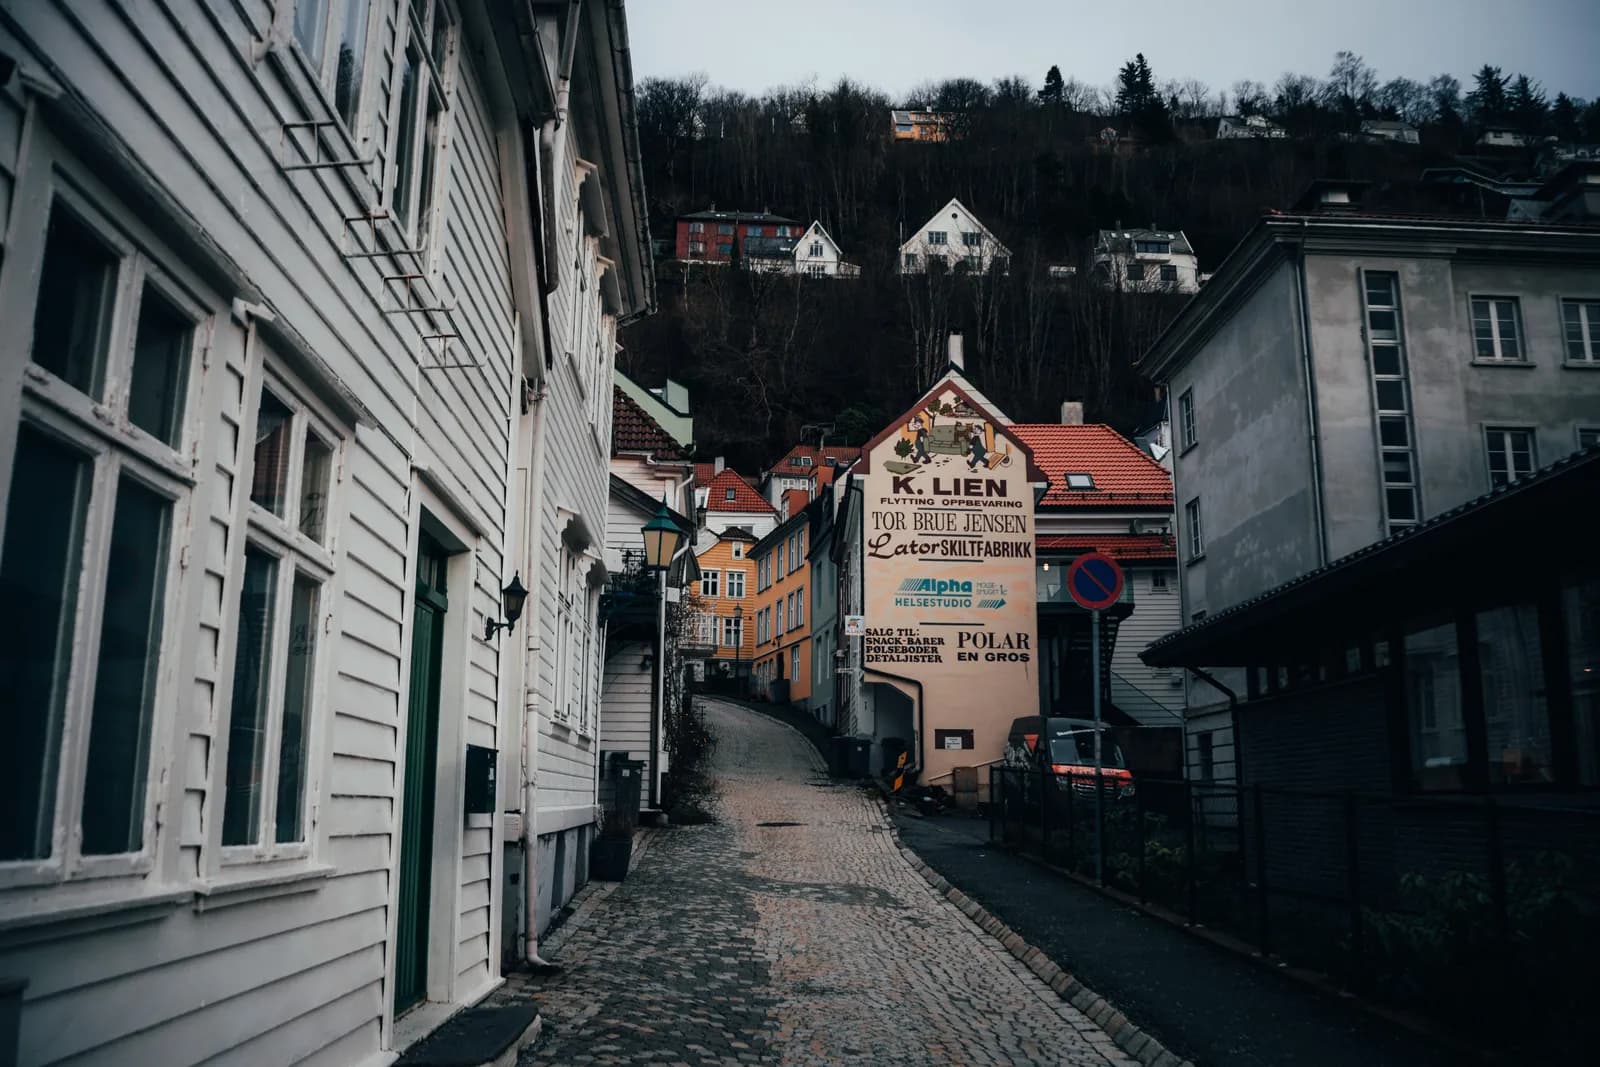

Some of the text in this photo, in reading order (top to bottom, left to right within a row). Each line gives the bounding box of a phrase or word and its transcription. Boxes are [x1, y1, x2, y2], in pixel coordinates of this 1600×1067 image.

[893, 476, 1007, 497] K. LIEN
[880, 497, 1023, 508] FLYTTING OPPBEVARING
[872, 511, 1027, 533] TOR BRUE JENSEN
[868, 532, 1032, 560] Lator SKILTFABRIKK
[917, 578, 973, 596] Alpha
[895, 597, 972, 608] HELSESTUDIO
[865, 628, 893, 637] SALG
[896, 628, 920, 637] TIL:
[865, 637, 945, 646] SNACK-BARER
[957, 631, 1030, 650] POLAR
[865, 645, 939, 654] PØLSEBODER
[865, 654, 943, 663] DETALJISTER
[957, 652, 1030, 662] EN GROS
